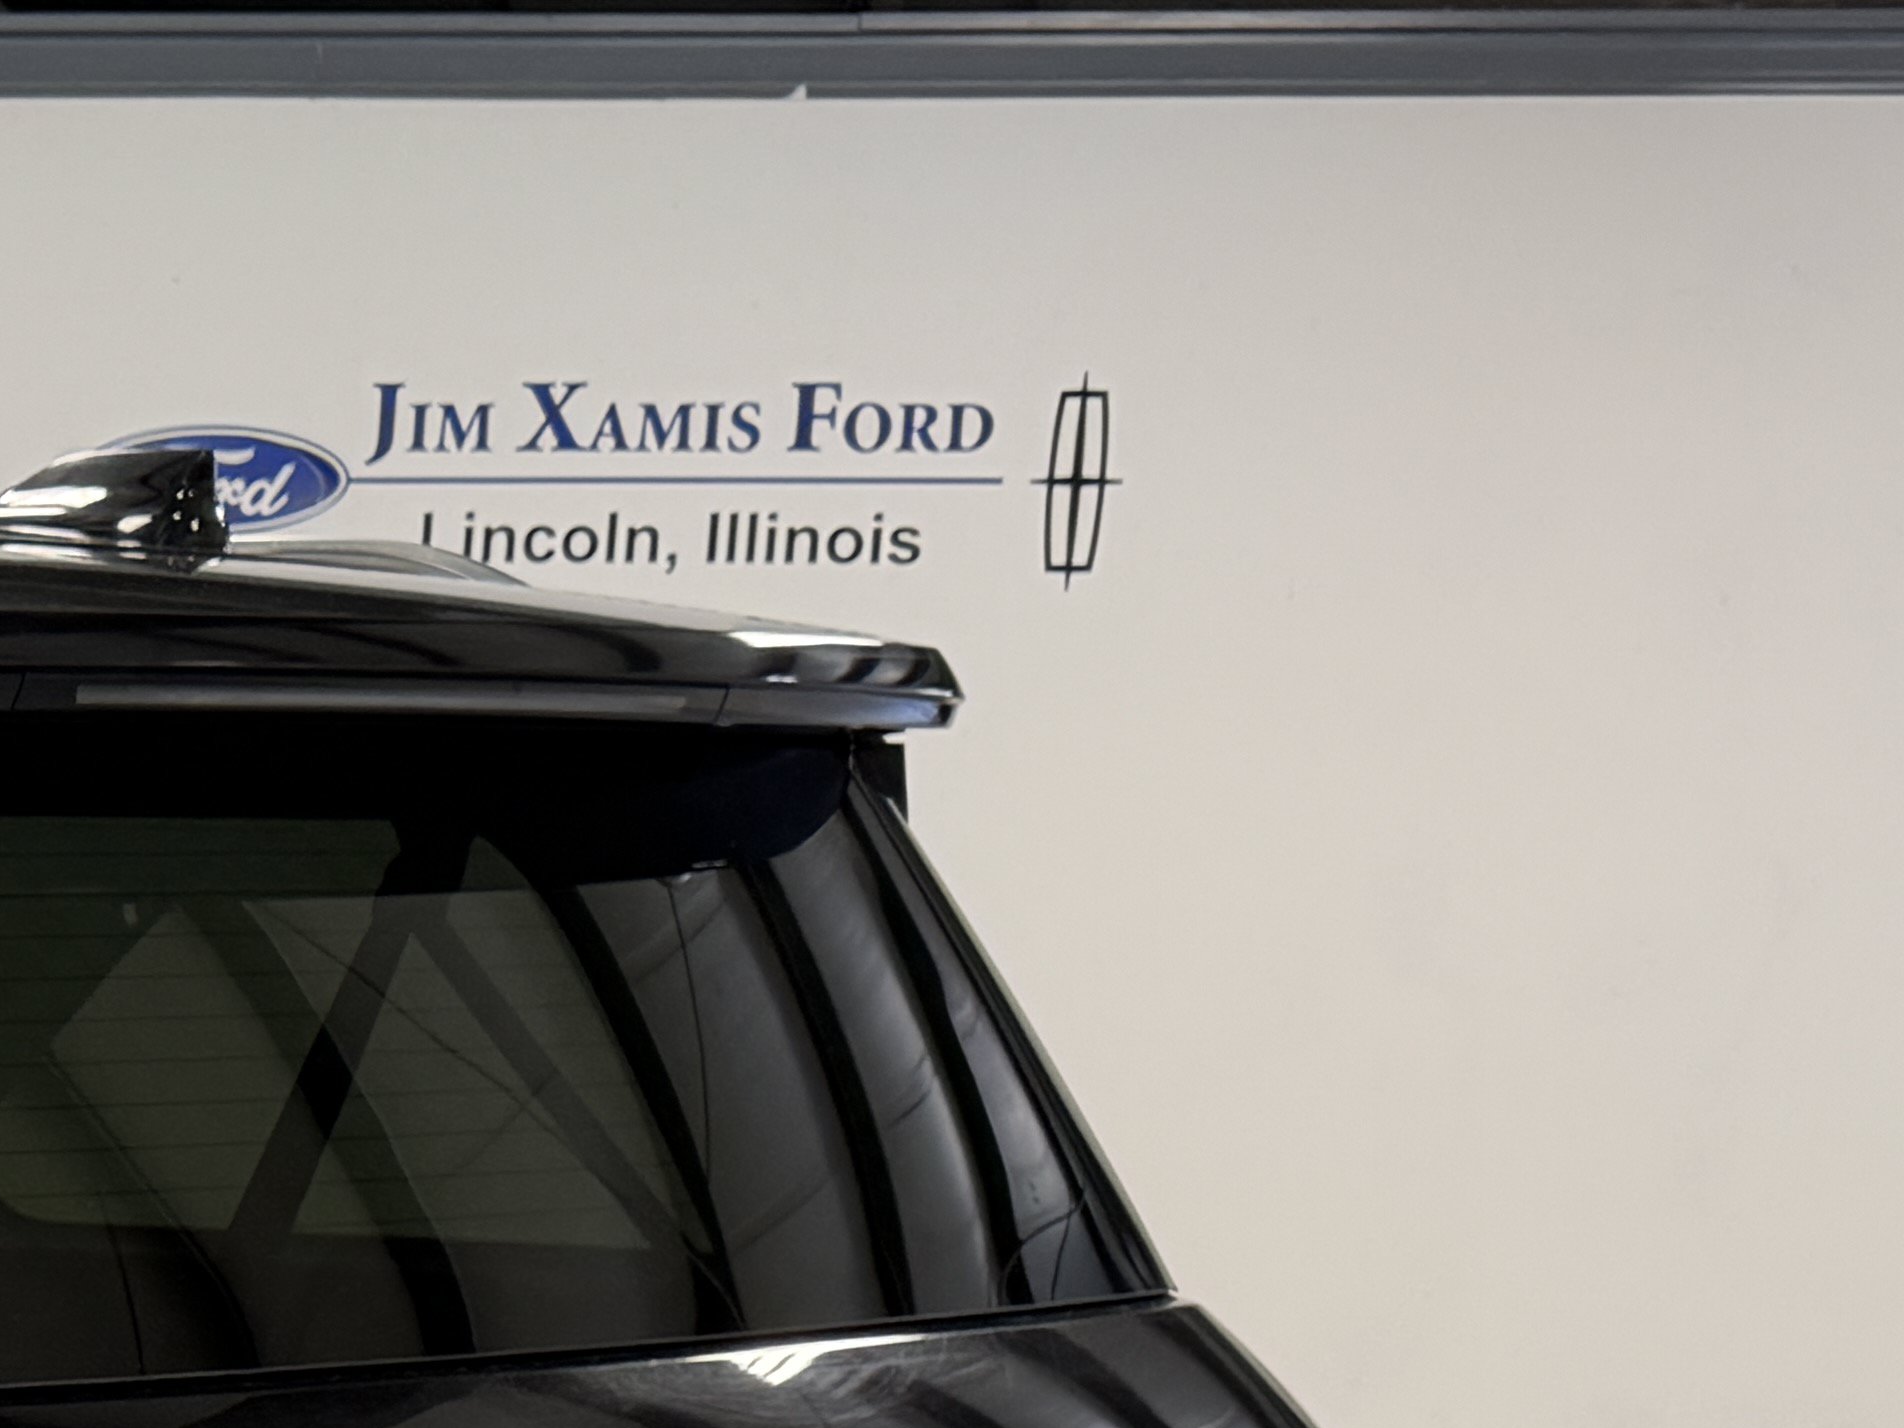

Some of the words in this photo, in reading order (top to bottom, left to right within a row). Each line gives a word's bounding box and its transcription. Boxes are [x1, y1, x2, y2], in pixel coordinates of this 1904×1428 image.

[365, 382, 495, 466] JIM
[515, 381, 761, 454] XAMIS
[786, 381, 995, 453] FORD
[421, 511, 678, 575] Lincoln,
[705, 511, 921, 564] Illinois
